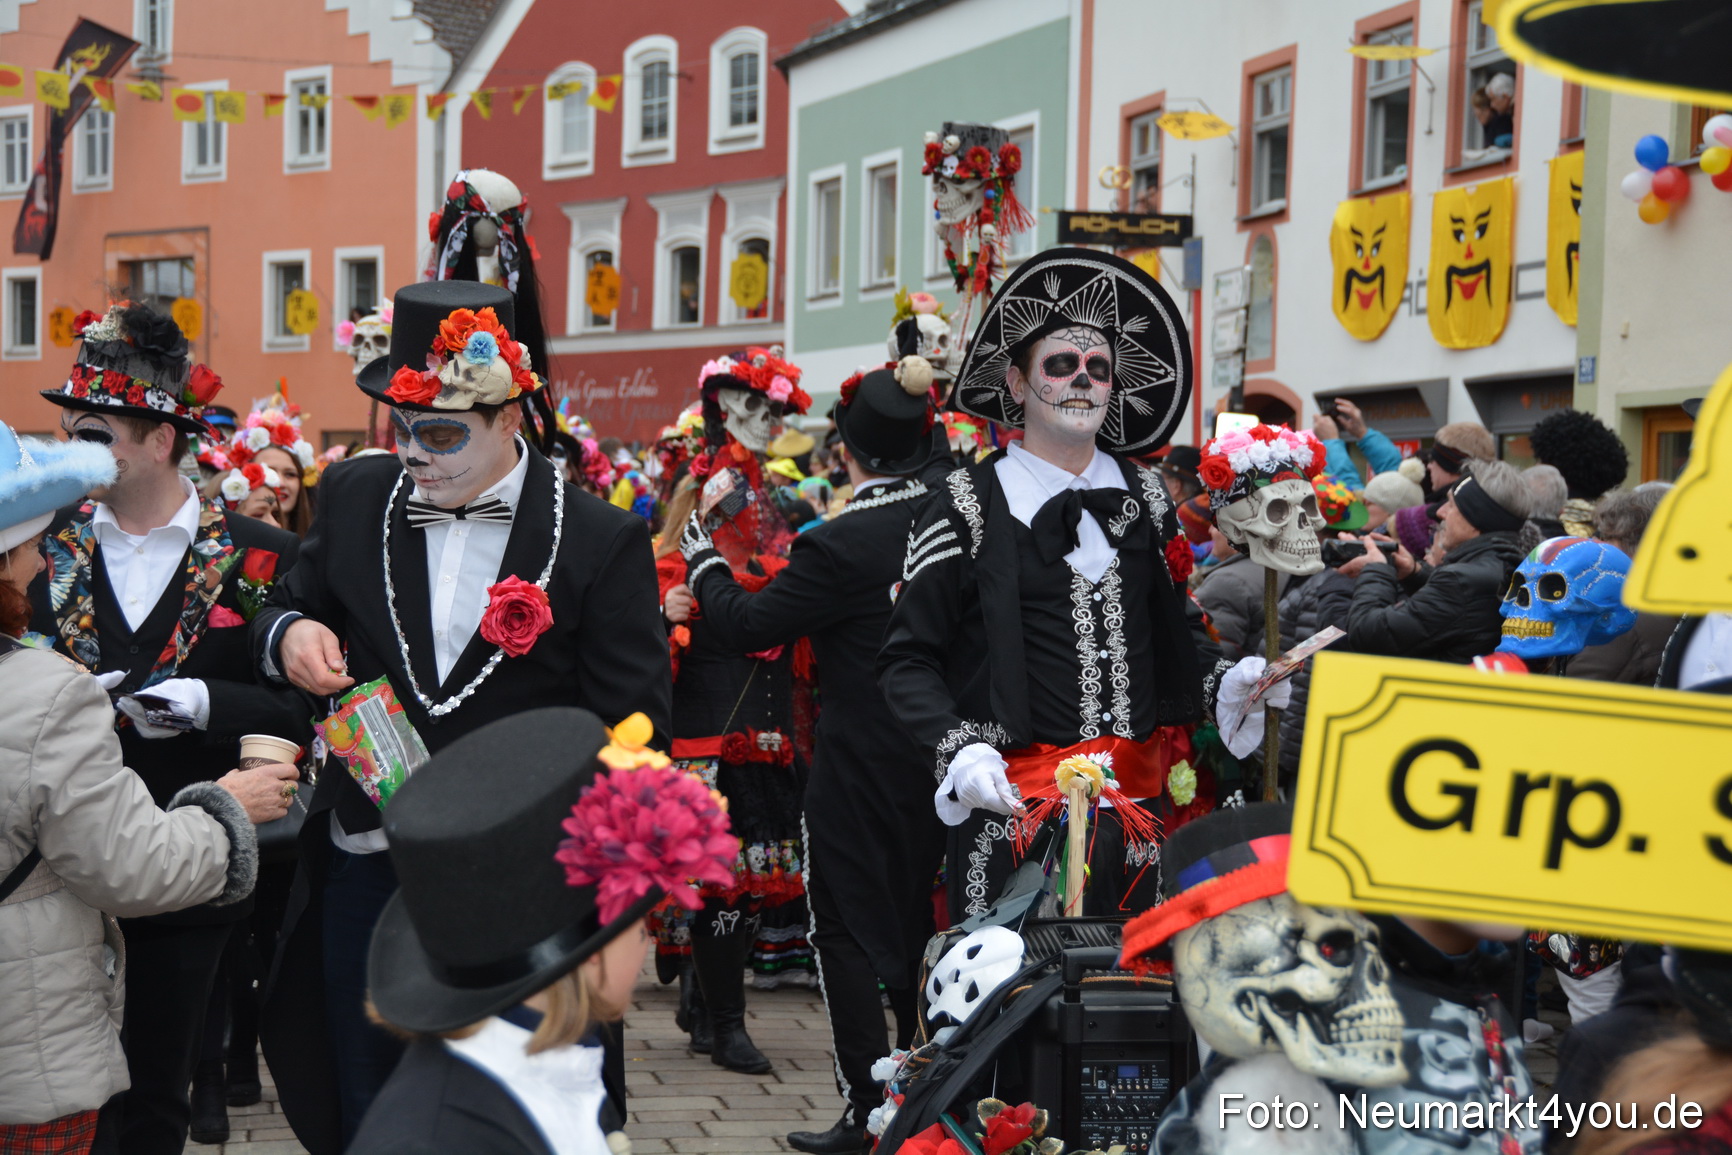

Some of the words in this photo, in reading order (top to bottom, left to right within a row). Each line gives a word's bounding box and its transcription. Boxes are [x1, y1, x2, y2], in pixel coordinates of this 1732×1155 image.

[1069, 214, 1180, 235] RÖHLICH
[245, 759, 266, 770] Coffee
[1388, 737, 1649, 871] Grp.
